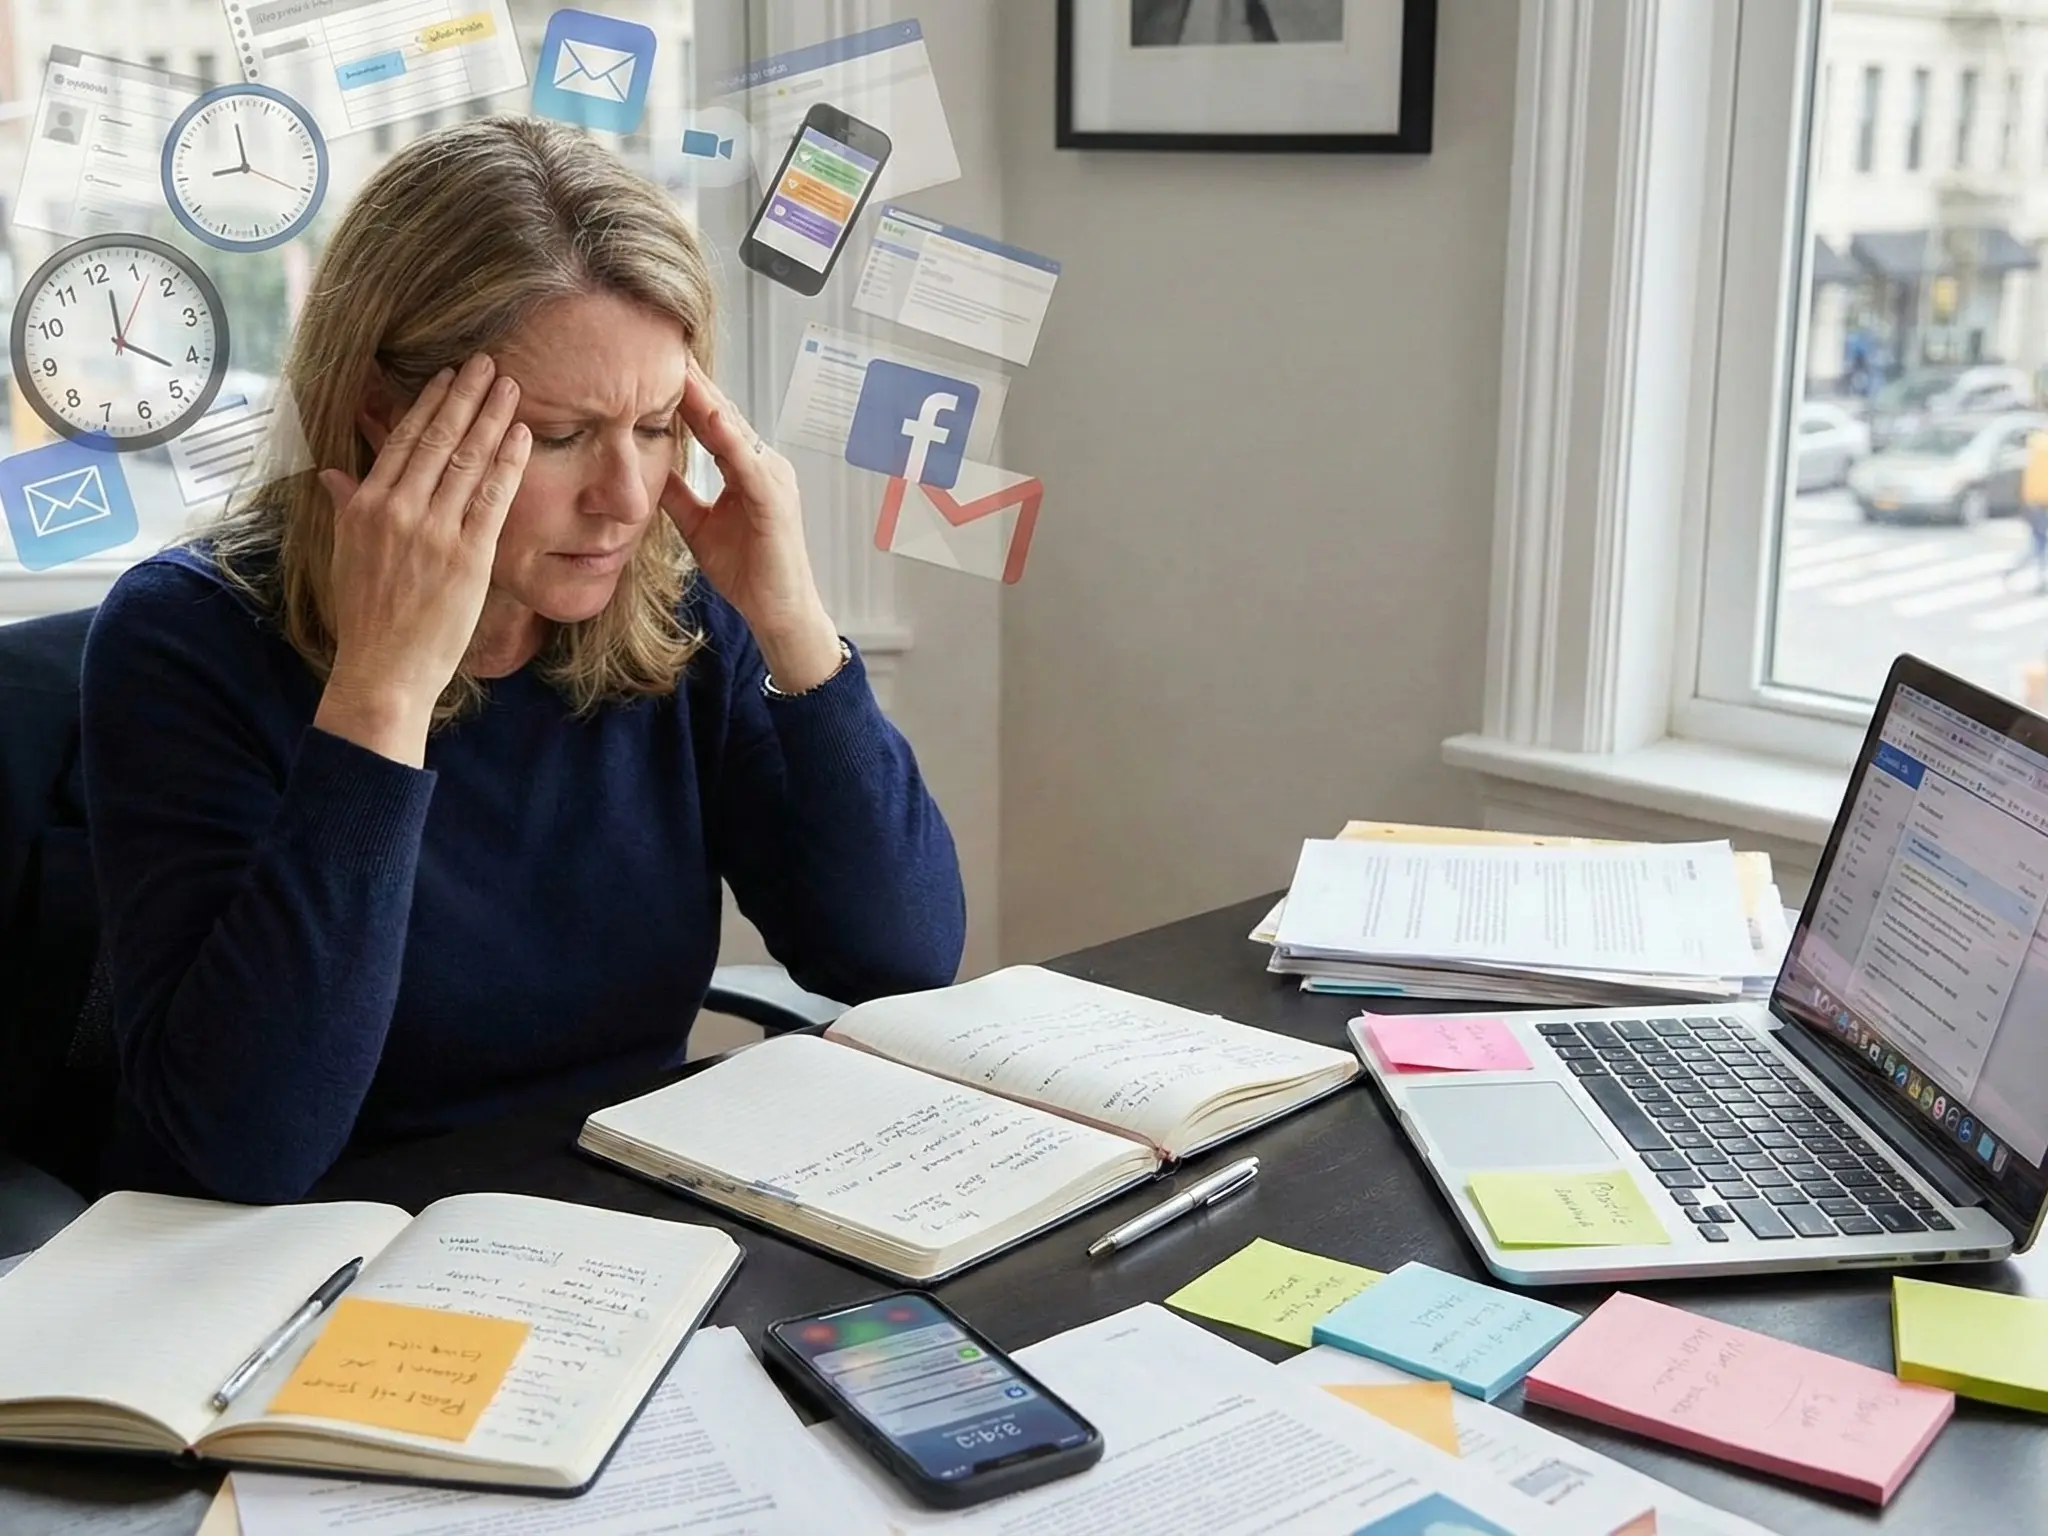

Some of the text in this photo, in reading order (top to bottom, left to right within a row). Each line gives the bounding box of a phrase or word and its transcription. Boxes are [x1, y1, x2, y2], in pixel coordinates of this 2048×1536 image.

[83, 264, 110, 286] 12
[128, 263, 140, 281] 1
[55, 285, 77, 307] 11
[160, 278, 175, 297] 2
[182, 308, 198, 327] 3
[38, 318, 64, 340] 10
[186, 345, 199, 364] 4
[43, 358, 57, 377] 9
[65, 389, 81, 408] 8
[169, 379, 183, 399] 5
[99, 402, 112, 422] 7
[137, 401, 152, 420] 6
[901, 392, 959, 484] f
